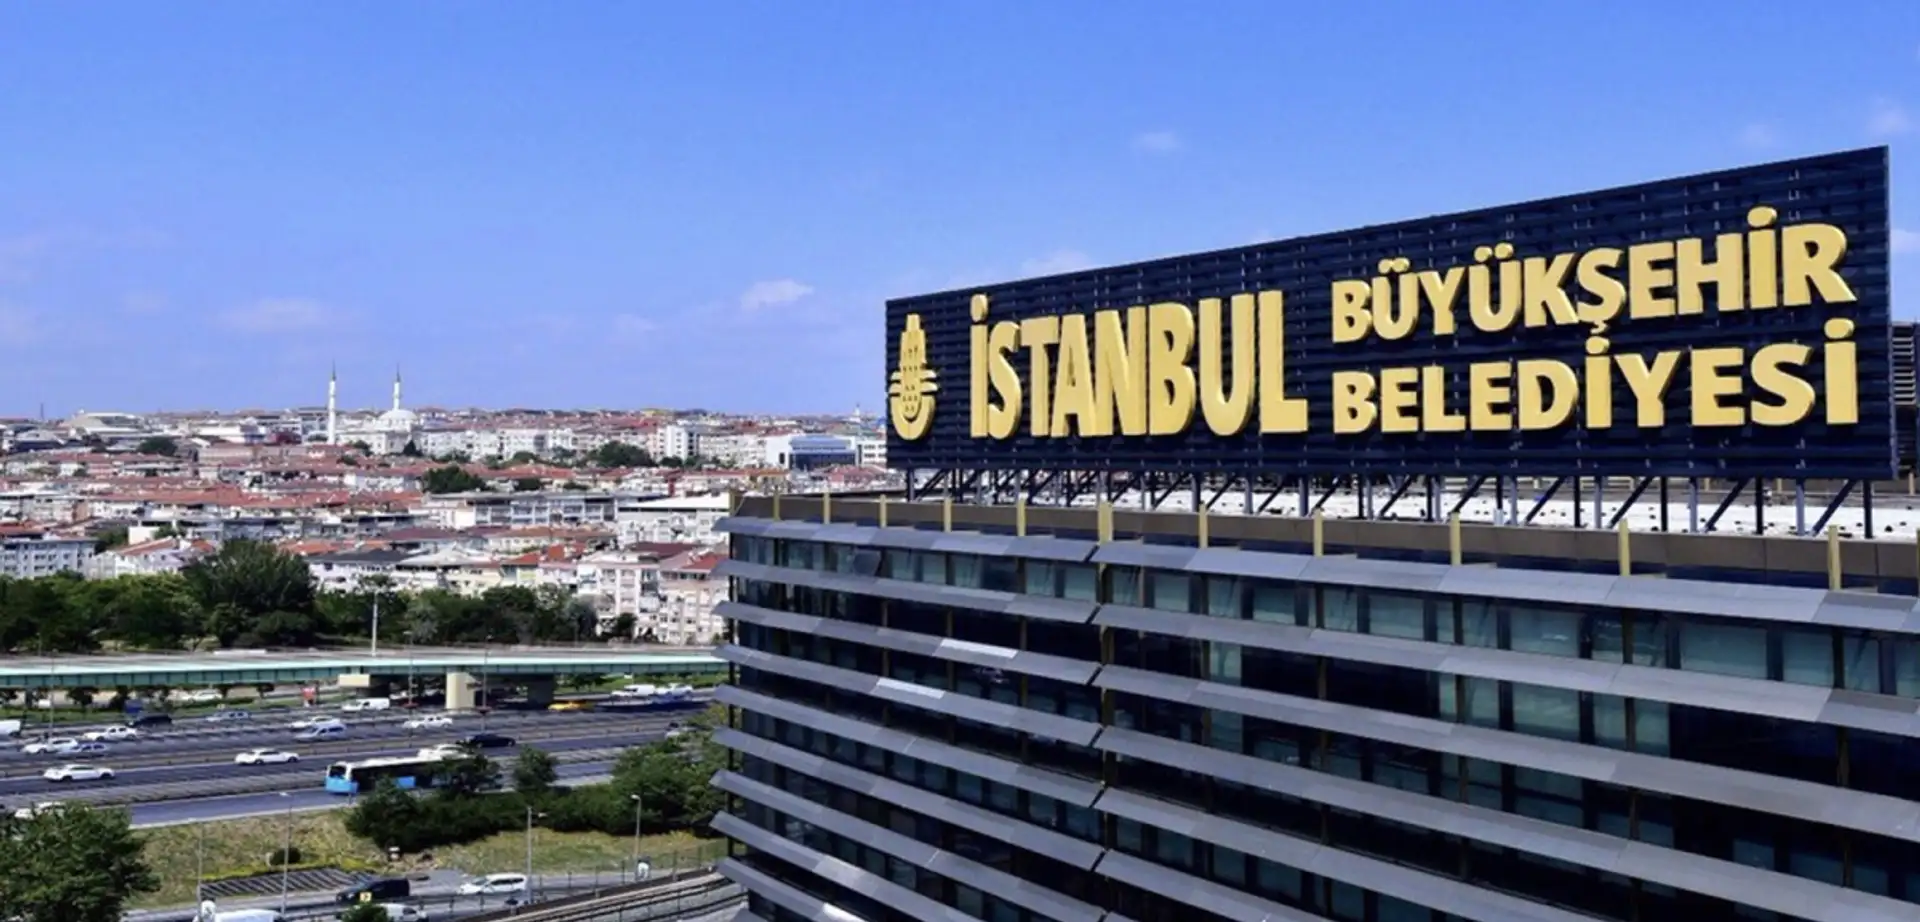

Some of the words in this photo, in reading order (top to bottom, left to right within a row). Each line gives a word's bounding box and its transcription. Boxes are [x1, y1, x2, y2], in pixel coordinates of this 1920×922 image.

[1332, 206, 1856, 343] BÜYÜKŞEHİR
[970, 290, 1308, 438] İSTANBUL
[1332, 318, 1858, 434] BELEDİYESİ
